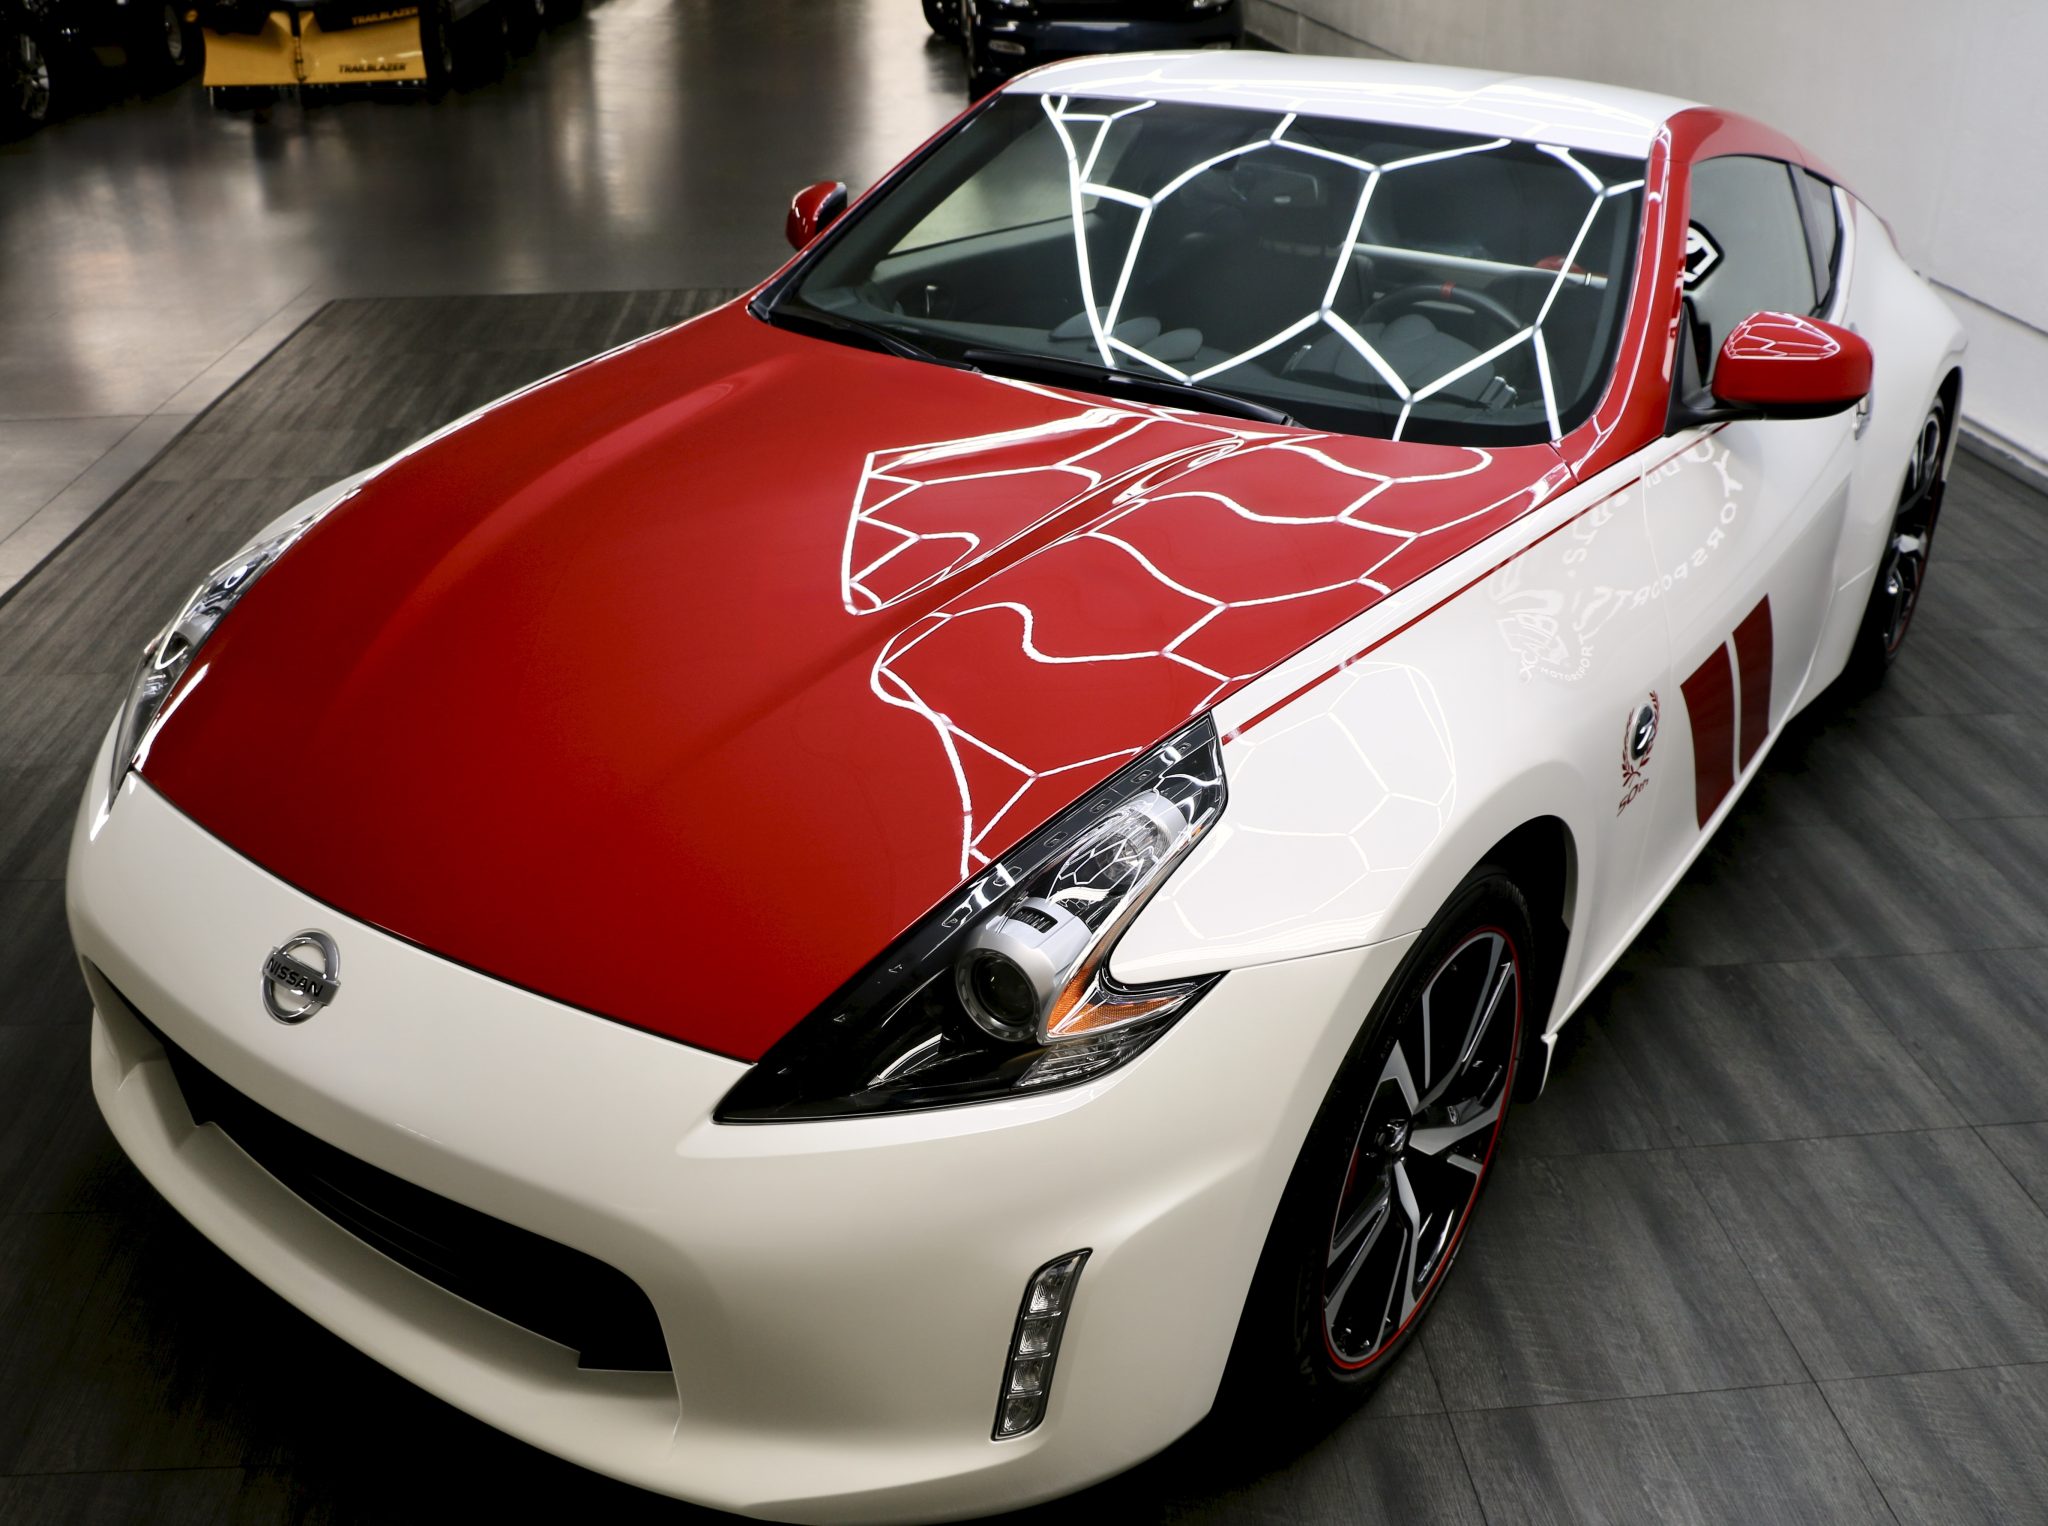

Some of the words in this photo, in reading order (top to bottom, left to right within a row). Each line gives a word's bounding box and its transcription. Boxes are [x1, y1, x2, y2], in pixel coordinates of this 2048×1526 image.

[351, 6, 418, 26] TRAILBLAZER
[338, 63, 406, 74] TRAILBLAZER
[266, 958, 324, 998] NISSAN
